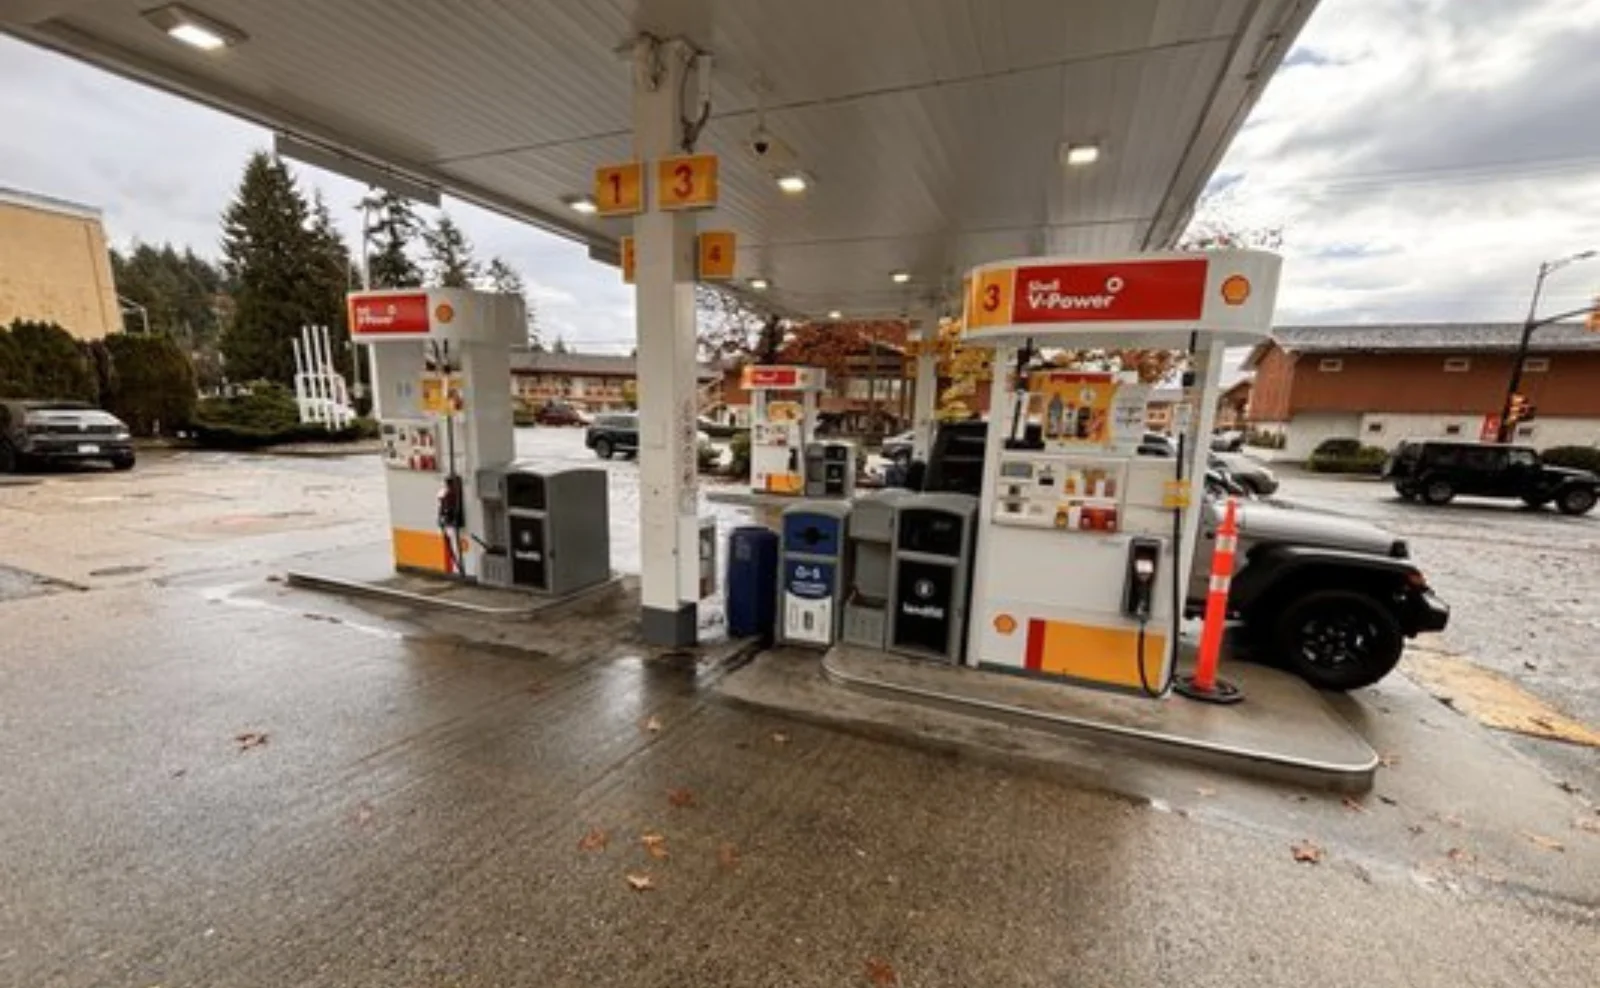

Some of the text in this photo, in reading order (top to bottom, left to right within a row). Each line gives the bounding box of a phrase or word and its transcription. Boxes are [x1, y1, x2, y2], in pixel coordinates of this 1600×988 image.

[609, 172, 621, 204] 1
[674, 163, 694, 198] 3
[708, 245, 721, 263] 4
[982, 283, 1000, 312] 3
[1028, 292, 1115, 309] V-Power
